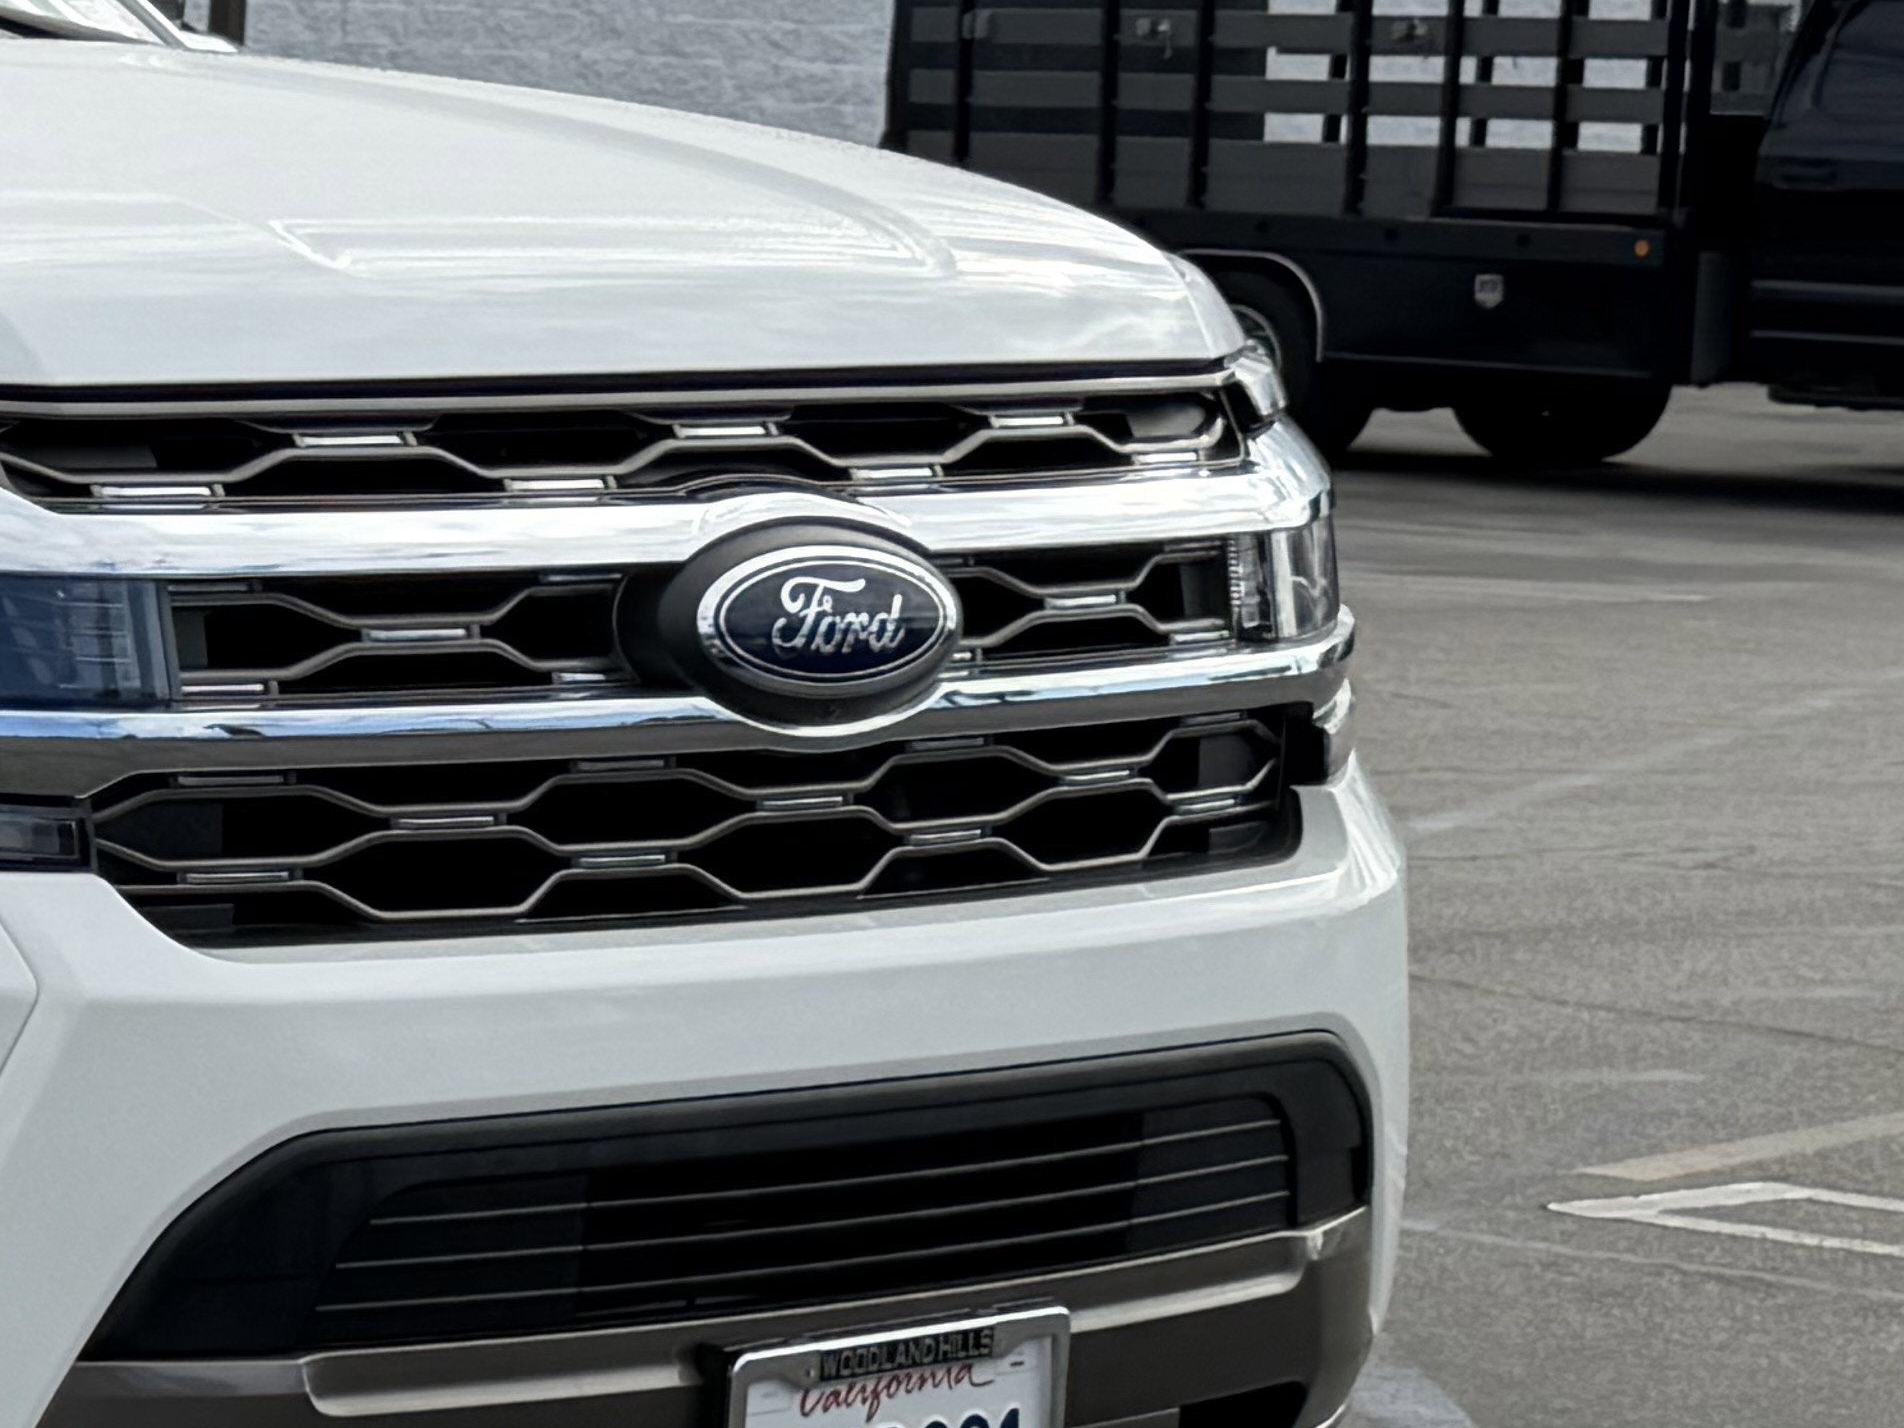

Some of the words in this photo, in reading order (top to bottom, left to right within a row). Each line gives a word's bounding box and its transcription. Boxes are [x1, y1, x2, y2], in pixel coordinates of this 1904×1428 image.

[771, 575, 906, 655] Ford
[821, 1337, 937, 1380] WOODLAND
[938, 1329, 992, 1362] HILLS
